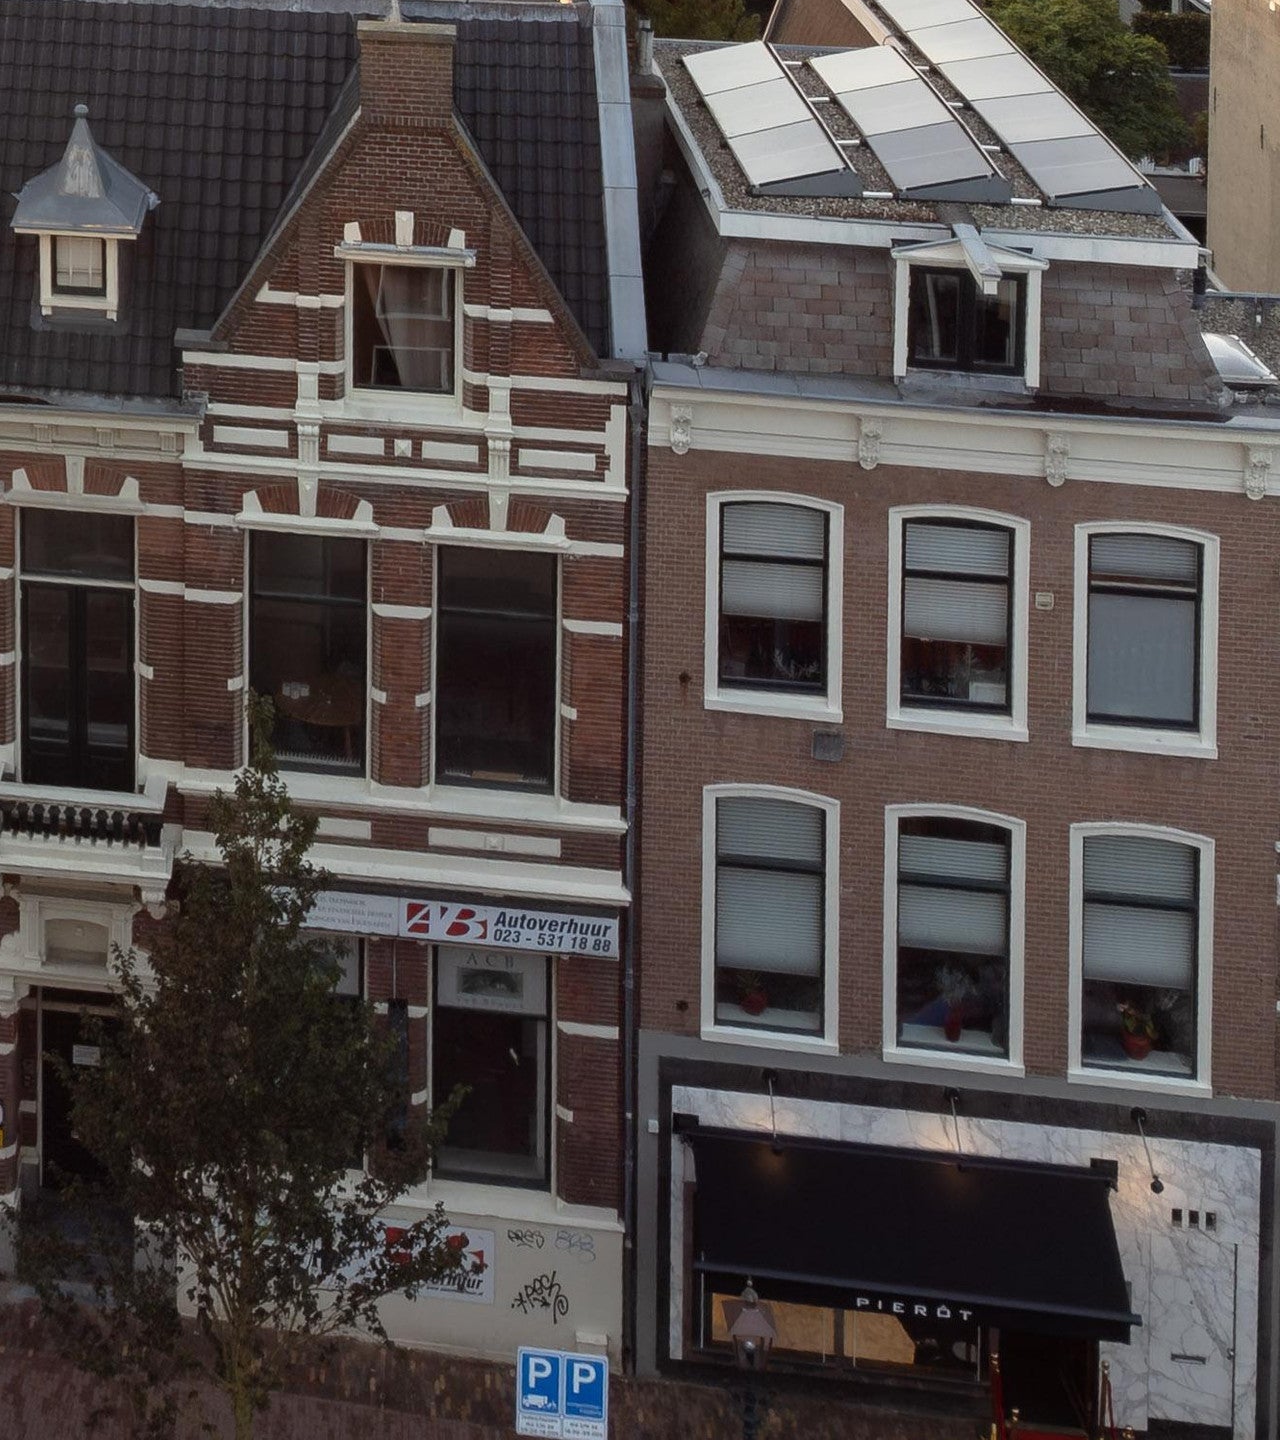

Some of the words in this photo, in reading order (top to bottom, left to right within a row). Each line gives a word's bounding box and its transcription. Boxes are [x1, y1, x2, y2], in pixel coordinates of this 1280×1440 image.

[493, 910, 612, 938] Autoverhuur
[493, 928, 521, 944] 023
[537, 933, 563, 949] 531
[570, 936, 588, 951] 18
[592, 937, 612, 953] 88
[528, 1356, 553, 1389] P
[572, 1361, 597, 1395] P
